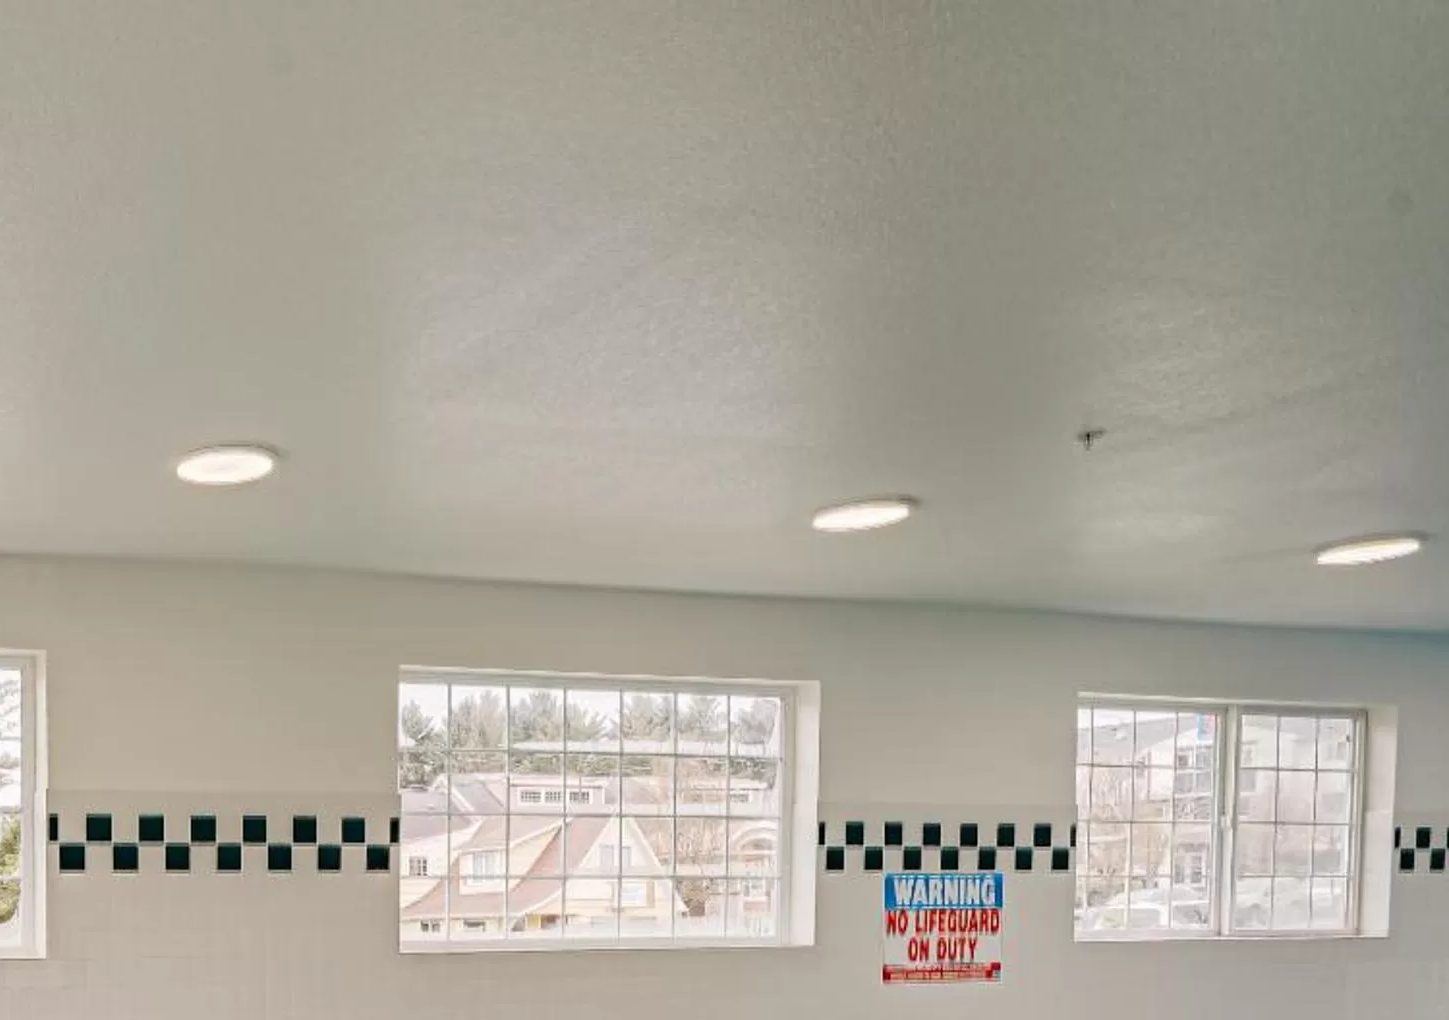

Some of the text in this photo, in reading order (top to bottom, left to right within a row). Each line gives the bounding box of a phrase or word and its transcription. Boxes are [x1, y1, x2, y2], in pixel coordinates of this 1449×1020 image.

[893, 877, 996, 906] WARNING
[886, 909, 1000, 935] NO LIFEGUARD
[907, 937, 978, 962] ON DUTY
